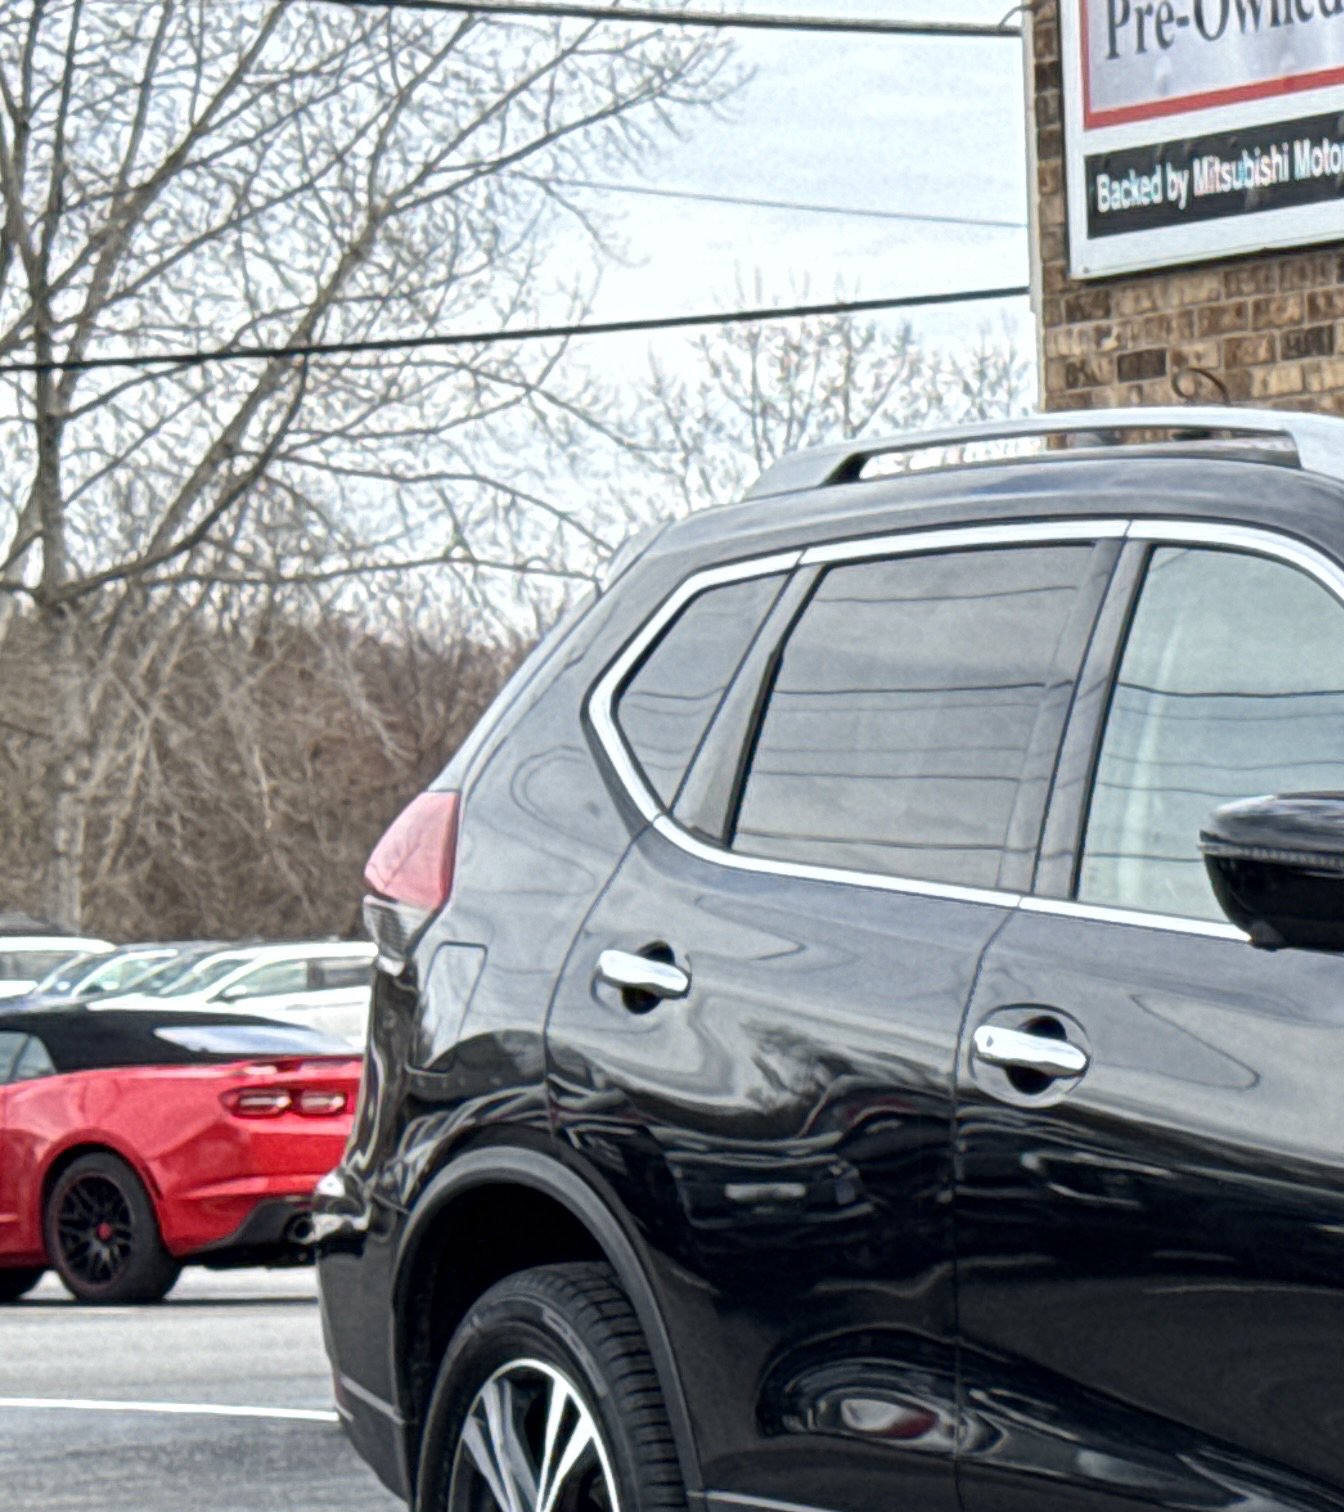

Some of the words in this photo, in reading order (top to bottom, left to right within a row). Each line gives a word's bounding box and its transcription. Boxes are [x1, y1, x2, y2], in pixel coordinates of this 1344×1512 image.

[1096, 165, 1162, 214] Backed
[1166, 161, 1190, 209] by
[1193, 142, 1290, 198] Mitsubishi
